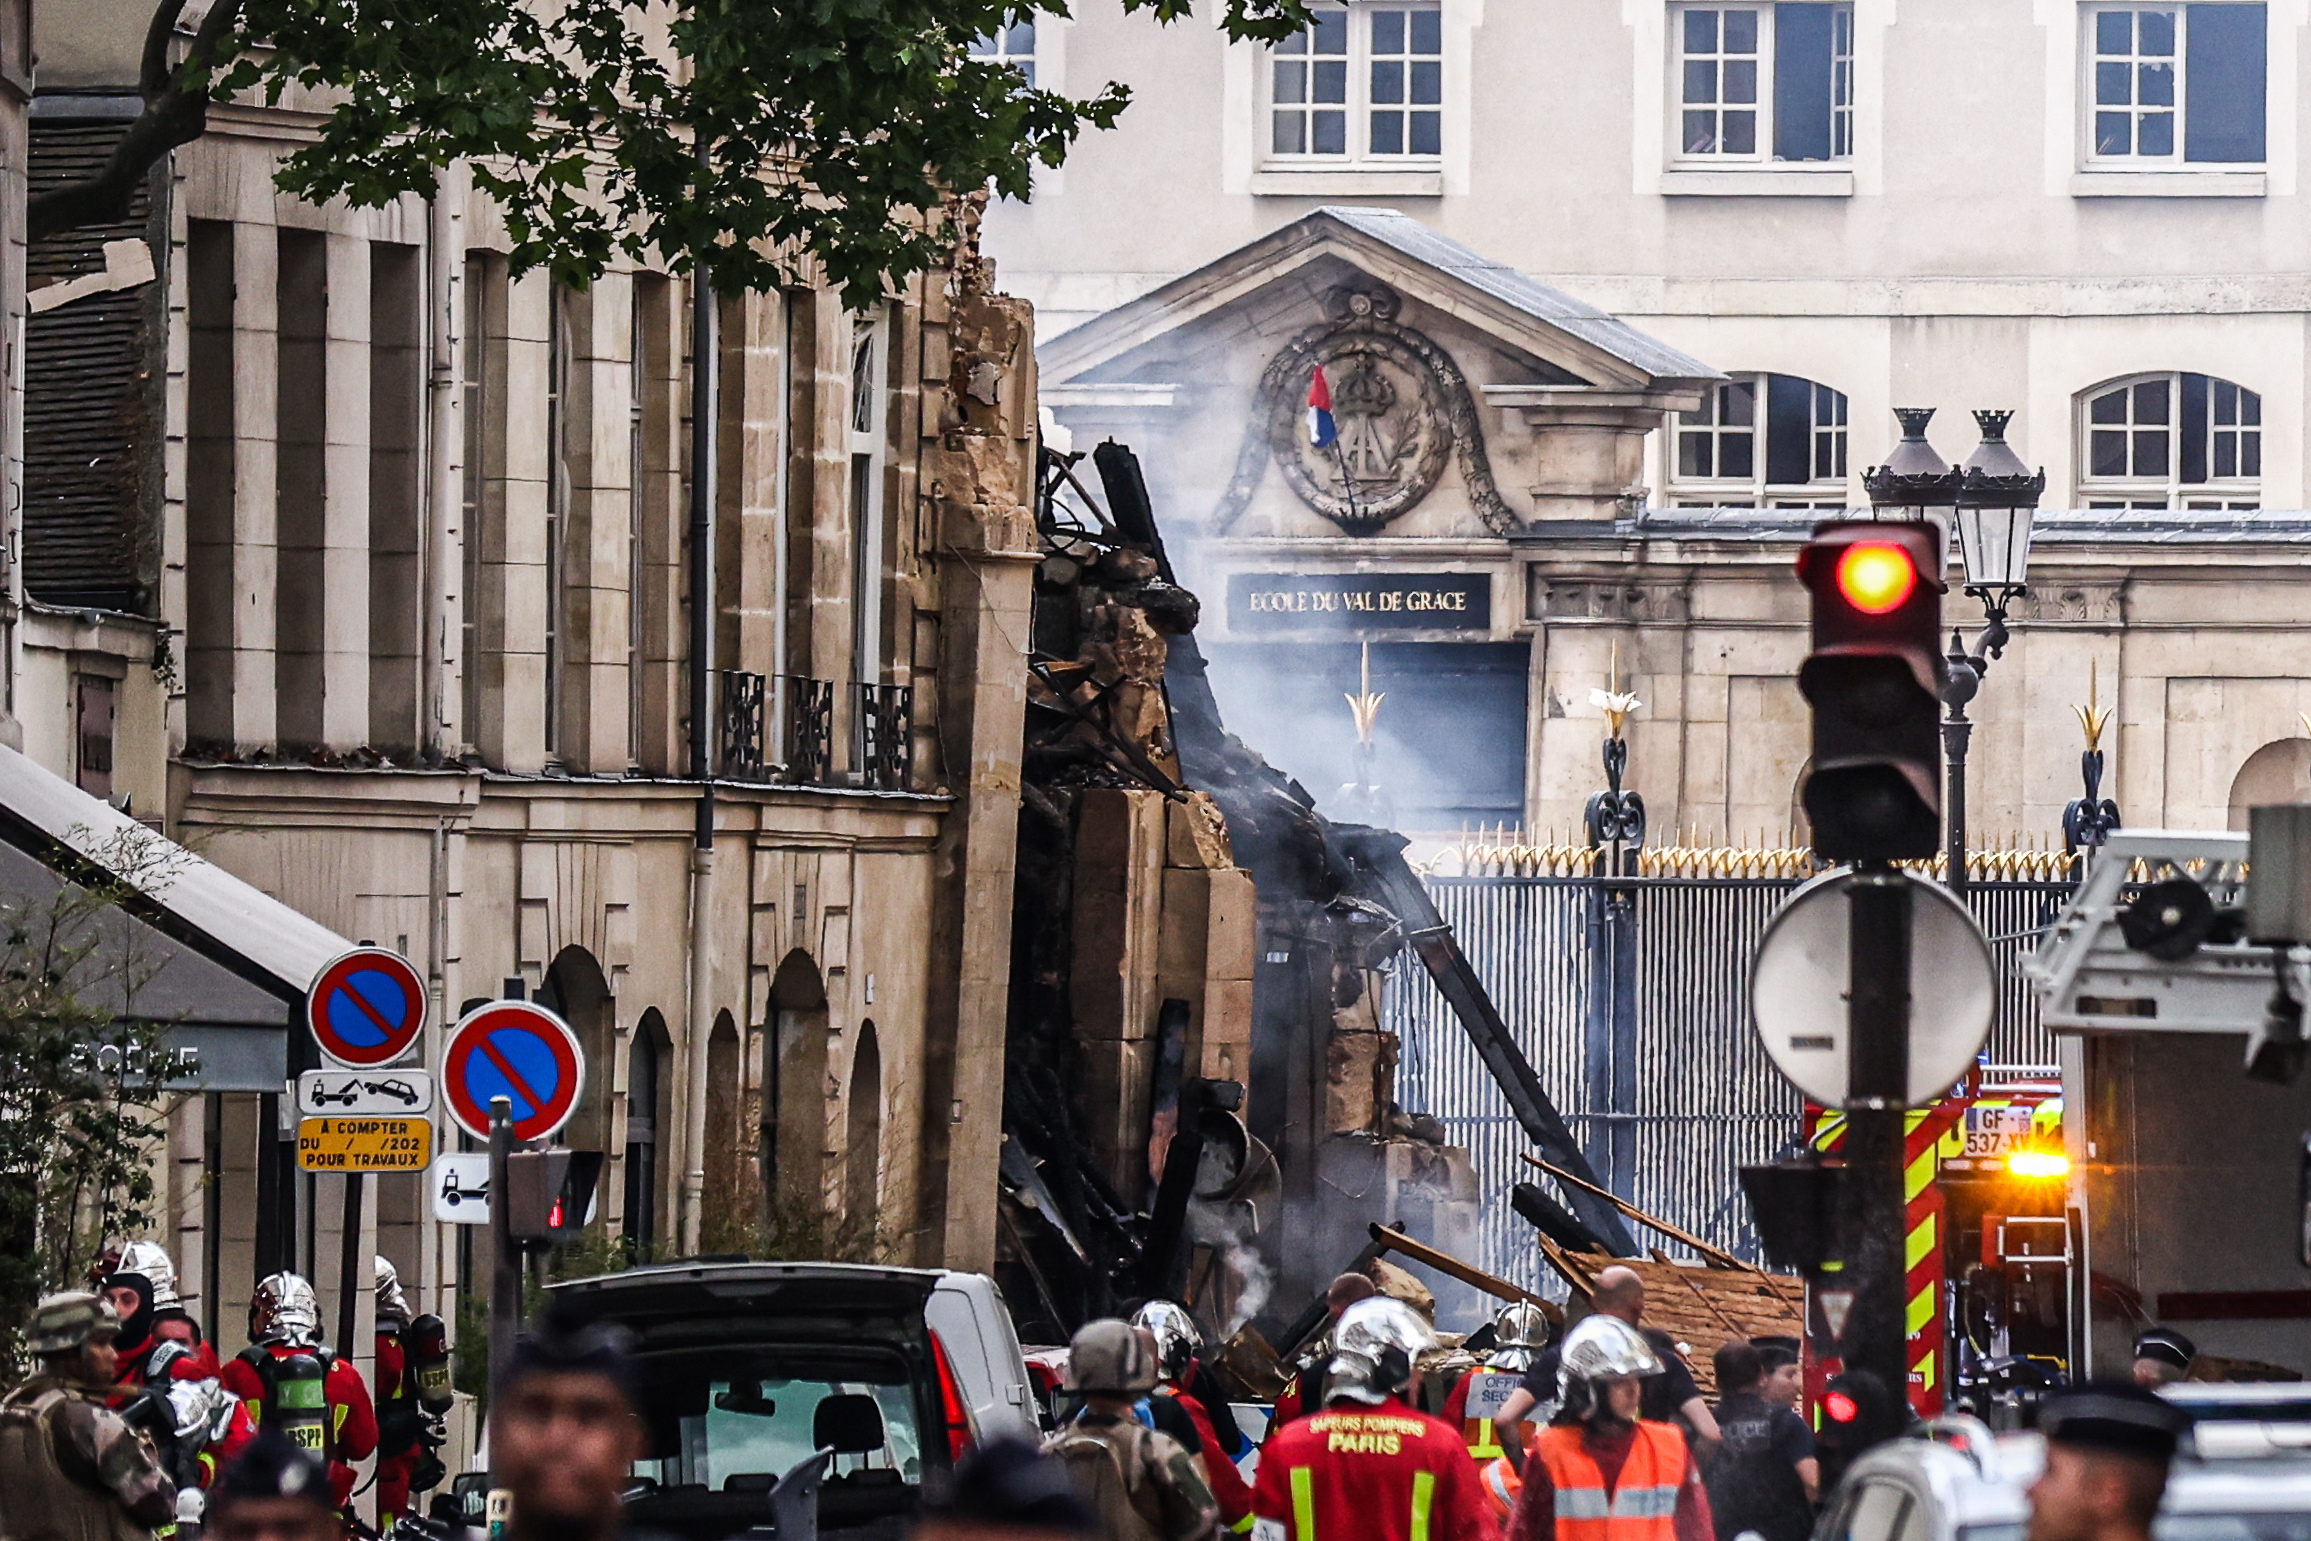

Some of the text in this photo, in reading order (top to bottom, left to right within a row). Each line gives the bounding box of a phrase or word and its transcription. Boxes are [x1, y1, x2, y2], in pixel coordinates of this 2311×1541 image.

[1312, 592, 1338, 612] DU
[1342, 592, 1375, 611] VAL
[1379, 592, 1402, 612] DE
[337, 1122, 408, 1134] COMPTER
[300, 1138, 319, 1149] DU
[380, 1138, 419, 1150] /202
[306, 1153, 417, 1166] POUR TRAVAUX
[1482, 1389, 1513, 1402] SEC
[1327, 1433, 1400, 1455] PARIS
